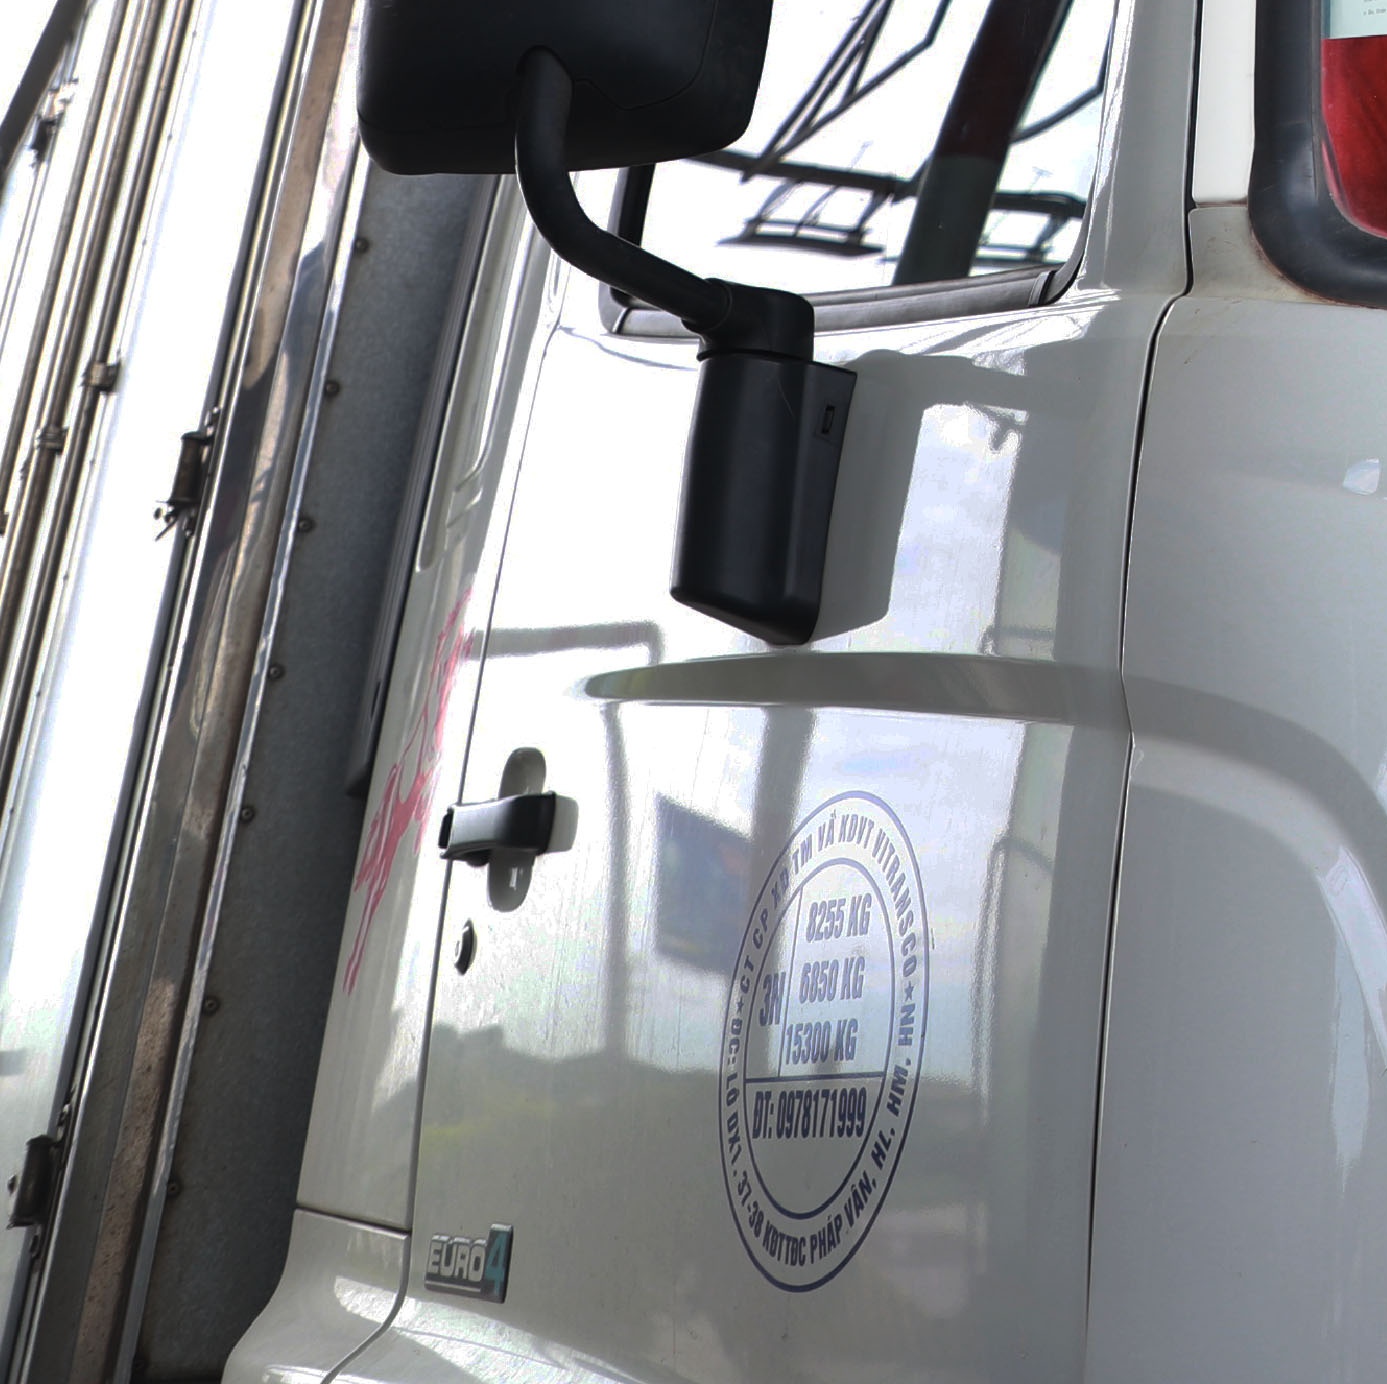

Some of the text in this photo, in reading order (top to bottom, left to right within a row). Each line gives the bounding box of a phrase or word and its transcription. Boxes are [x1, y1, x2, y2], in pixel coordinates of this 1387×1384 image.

[791, 833, 813, 875] TM
[872, 827, 918, 978] VITRANSCO
[805, 892, 873, 944] 8255 KG
[840, 955, 866, 1001] KG
[785, 1018, 859, 1066] 15300 KG
[776, 1086, 867, 1140] 0978171999
[809, 1212, 843, 1264] PHÁP
[897, 1003, 916, 1047] HN
